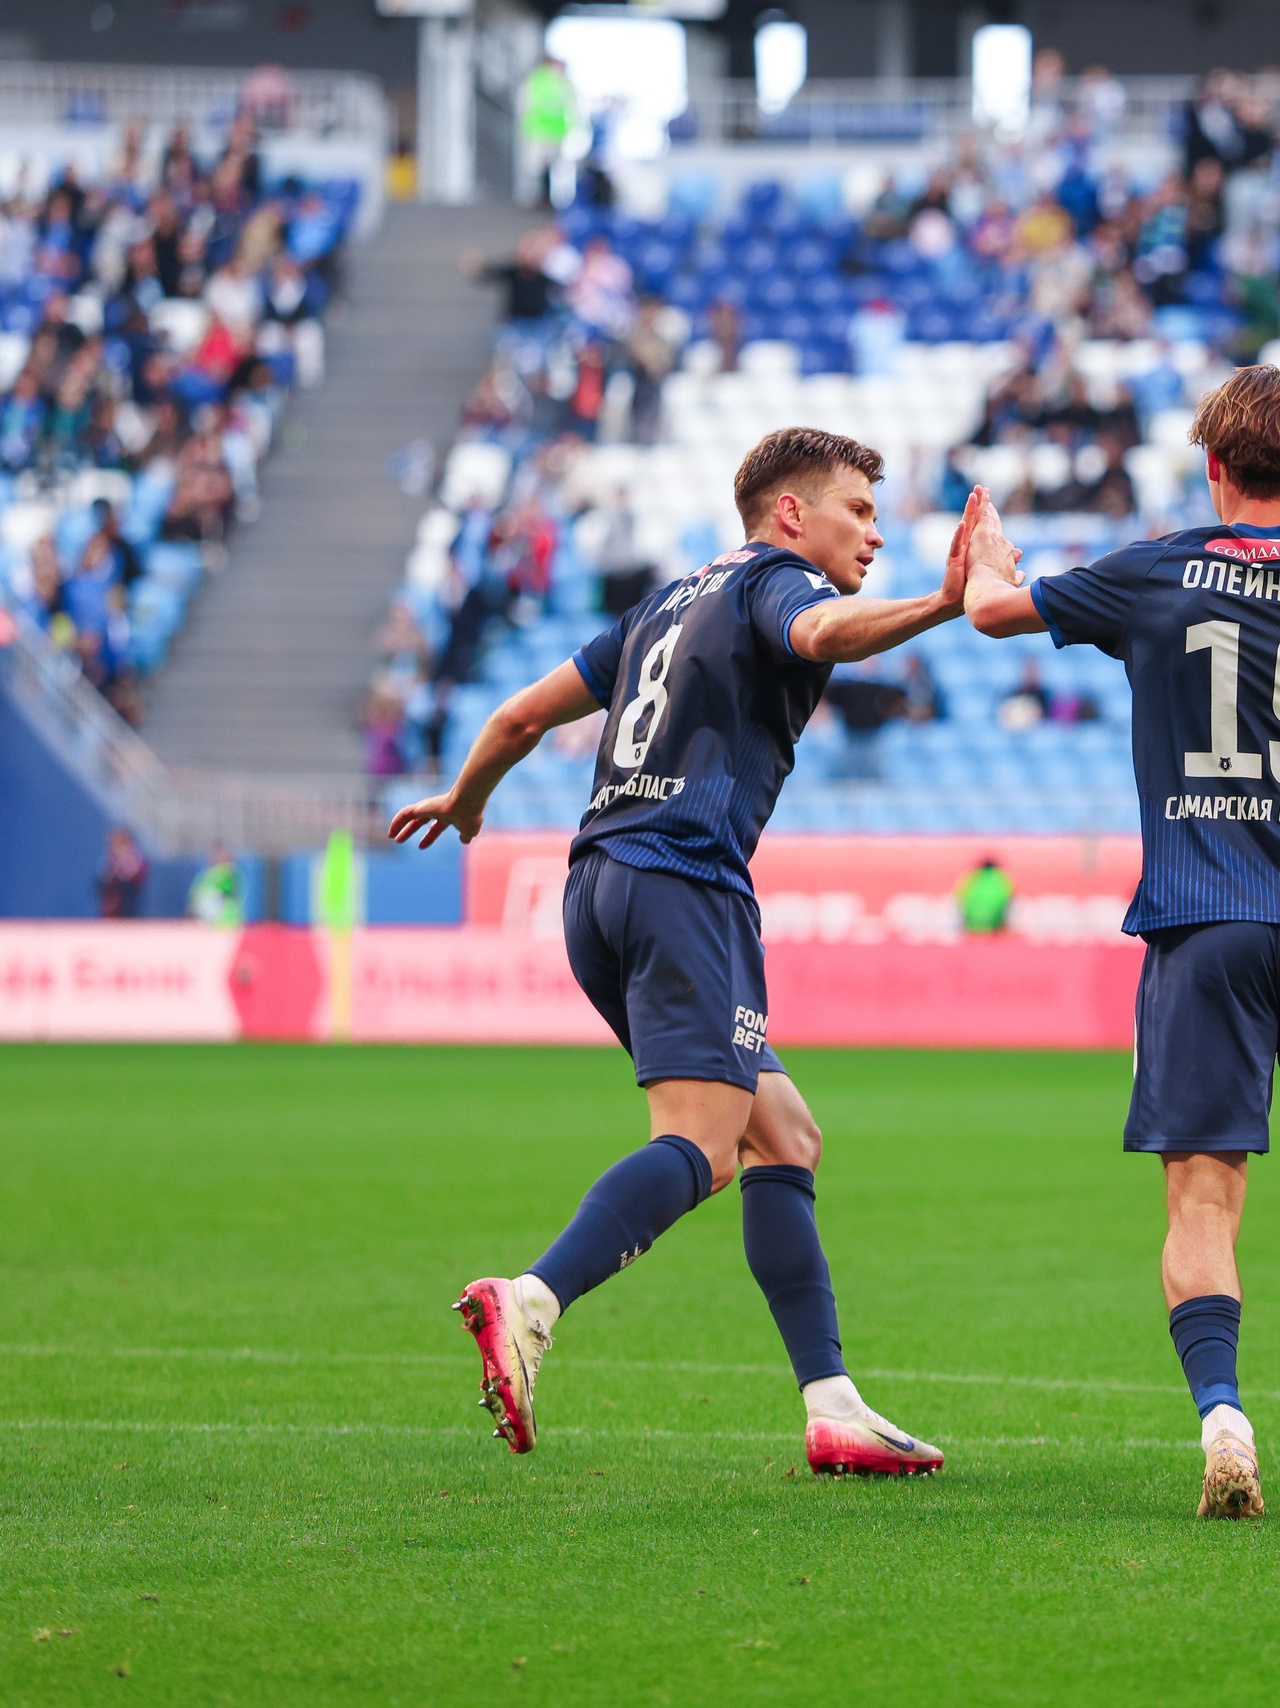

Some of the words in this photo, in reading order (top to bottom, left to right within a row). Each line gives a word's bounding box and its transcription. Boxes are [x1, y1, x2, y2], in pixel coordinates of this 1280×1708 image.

[613, 623, 684, 768] 8
[1165, 794, 1273, 822] САМАРСКАЯ
[734, 1004, 769, 1034] FON
[732, 1025, 766, 1054] BET
